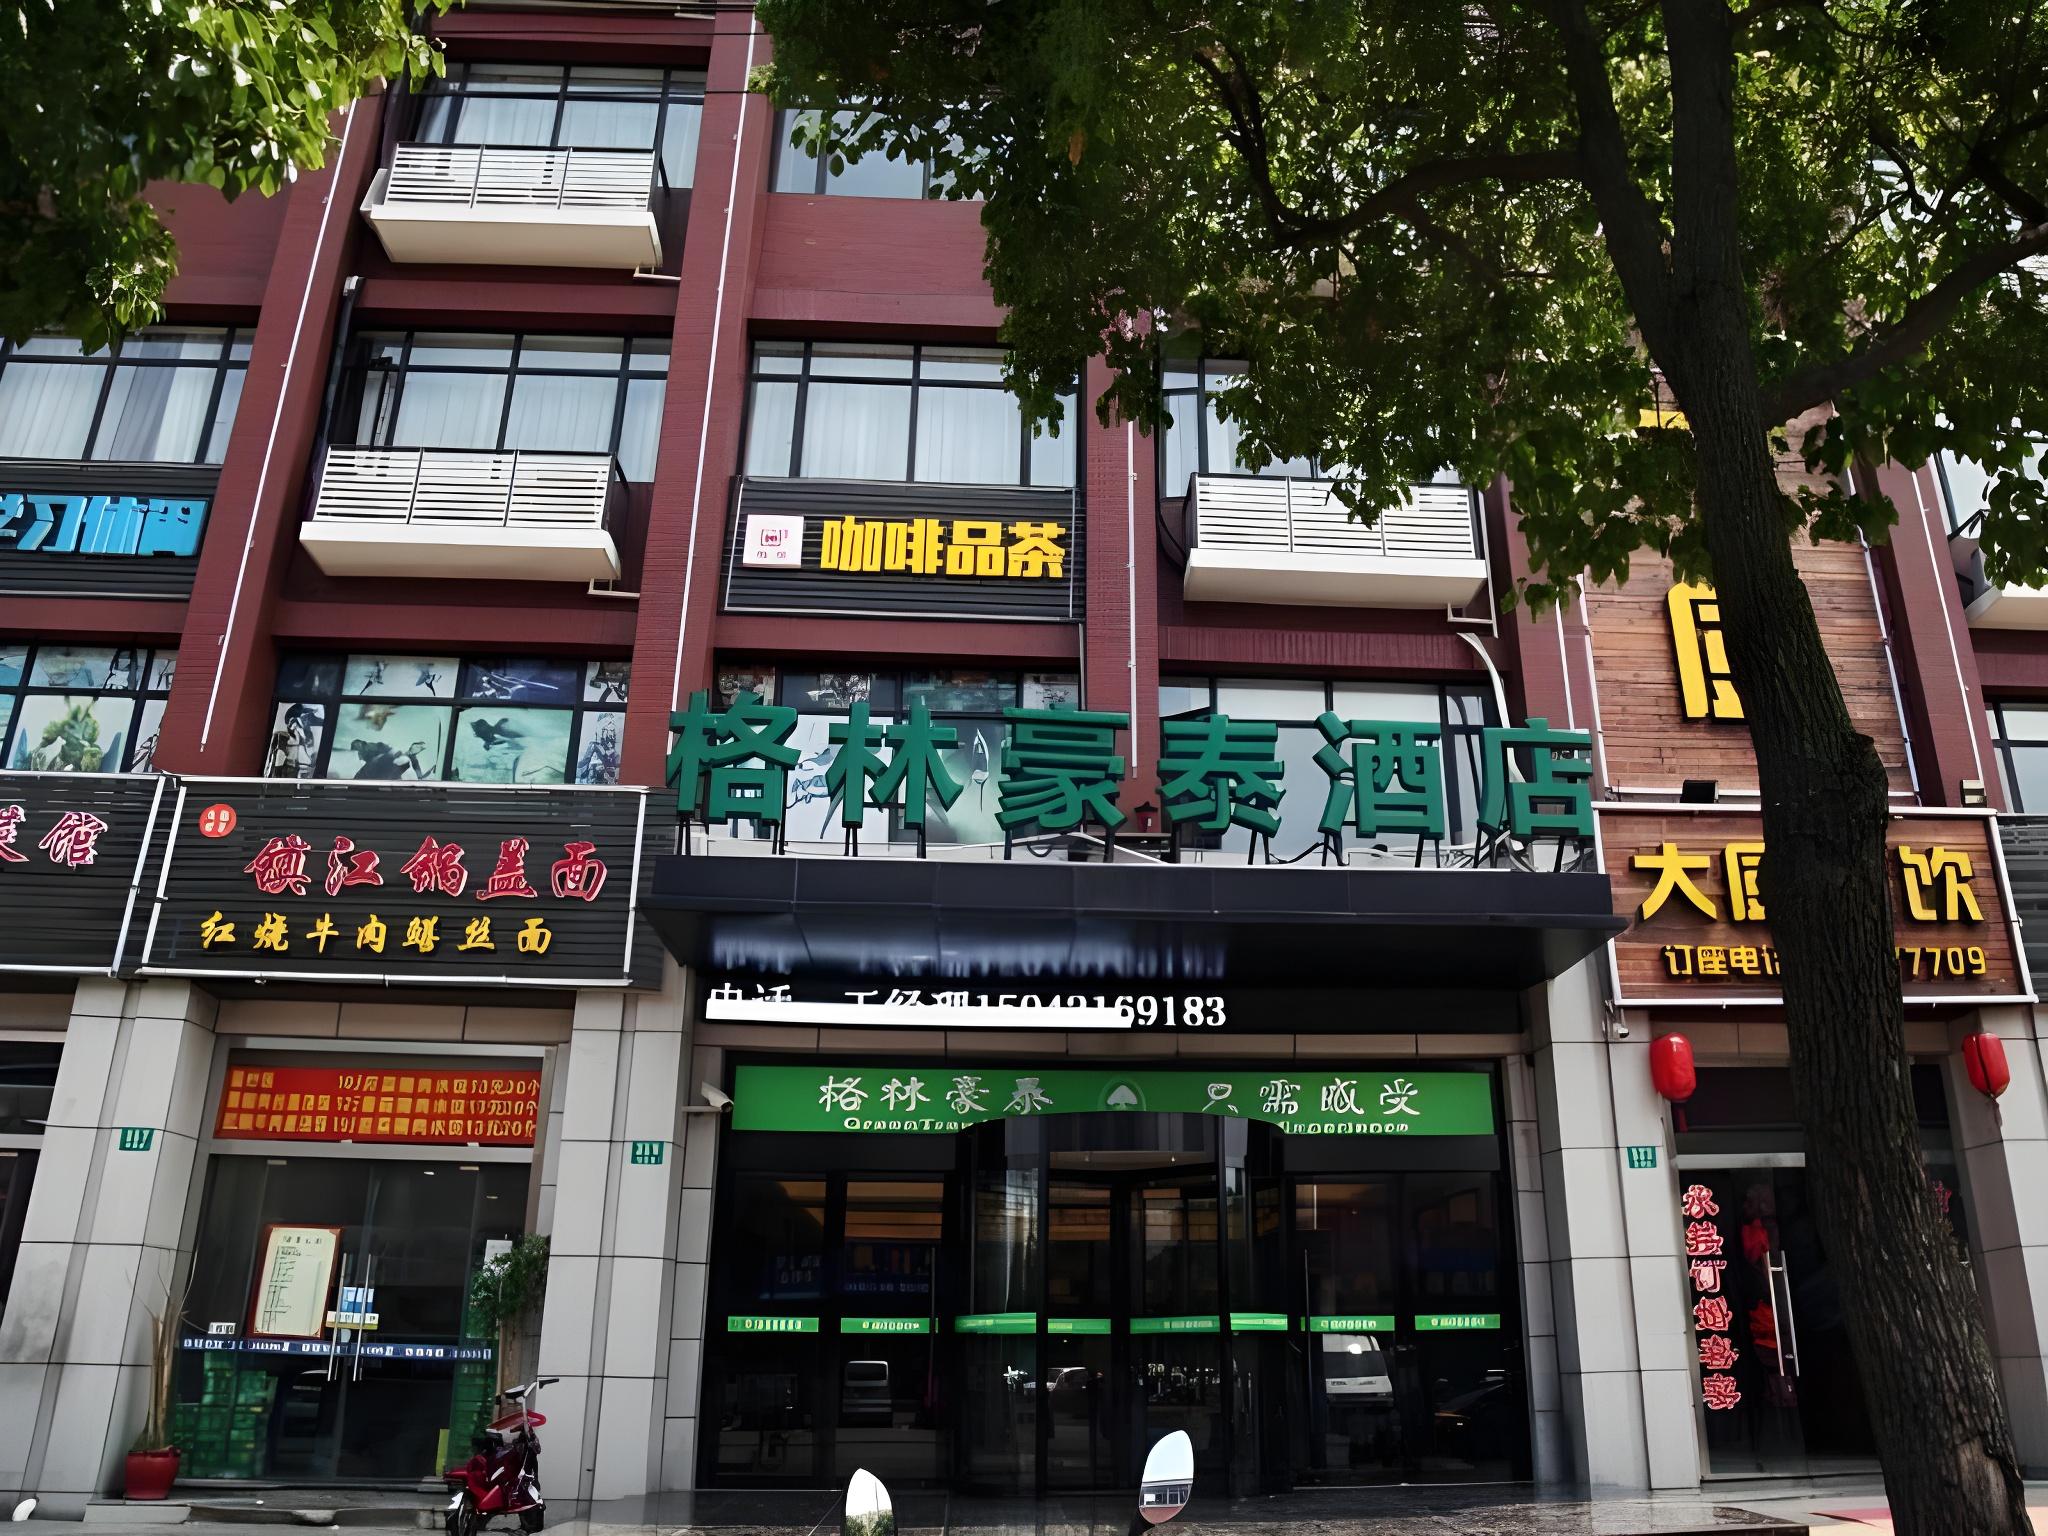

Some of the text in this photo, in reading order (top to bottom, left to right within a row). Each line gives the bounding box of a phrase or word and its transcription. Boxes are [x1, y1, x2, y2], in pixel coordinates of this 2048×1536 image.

[820, 515, 1067, 579] 咖啡品茶
[665, 689, 1594, 841] 格林豪泰酒店
[1630, 842, 1985, 923] 大饮
[818, 1075, 1054, 1115] 格林豪泰
